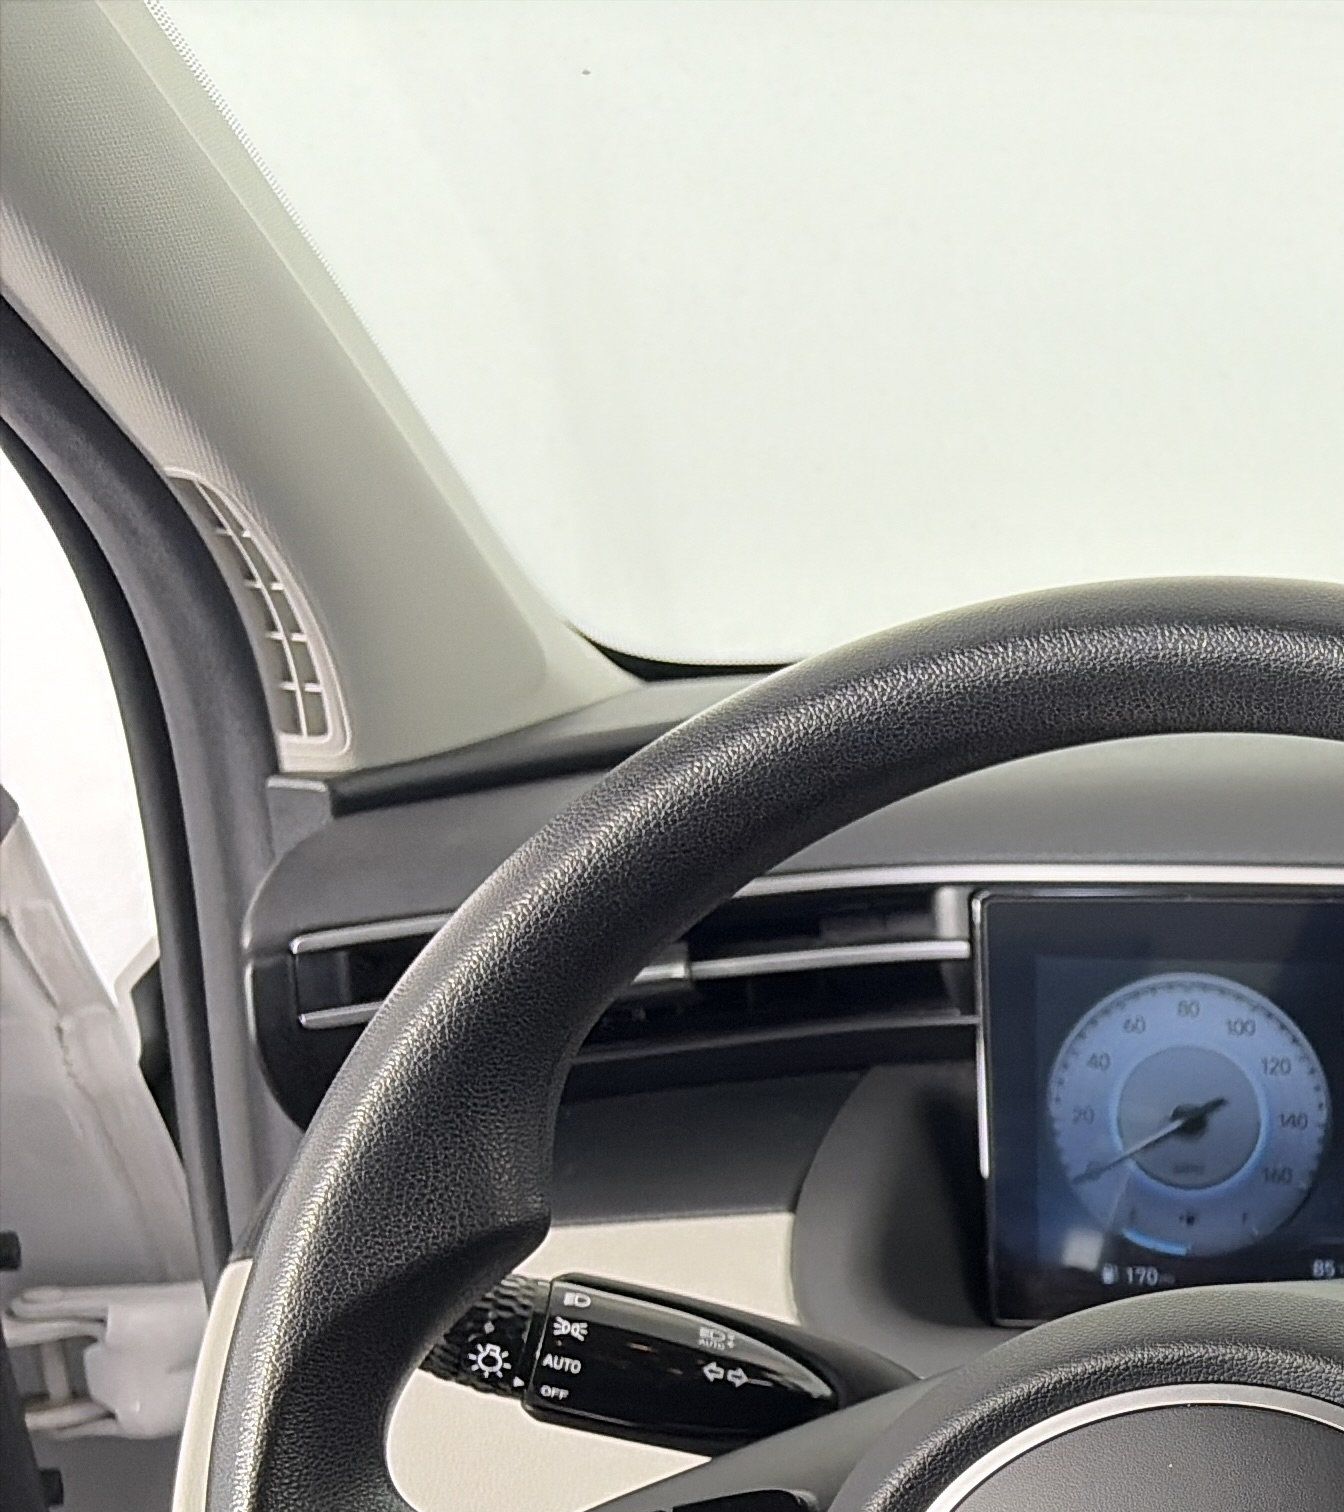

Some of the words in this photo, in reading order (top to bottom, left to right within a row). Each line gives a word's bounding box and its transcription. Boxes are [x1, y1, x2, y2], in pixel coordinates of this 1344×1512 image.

[1177, 1001, 1200, 1018] 80
[1123, 1017, 1146, 1034] 60
[1225, 1019, 1257, 1037] 100
[1086, 1053, 1111, 1071] 40
[1261, 1056, 1291, 1075] 120
[1073, 1108, 1095, 1125] 20
[1279, 1112, 1308, 1131] 140
[1262, 1167, 1293, 1185] 160
[1125, 1265, 1158, 1286] 170
[1312, 1258, 1336, 1279] 85
[542, 1353, 582, 1376] AUTO
[540, 1385, 569, 1400] OFF
